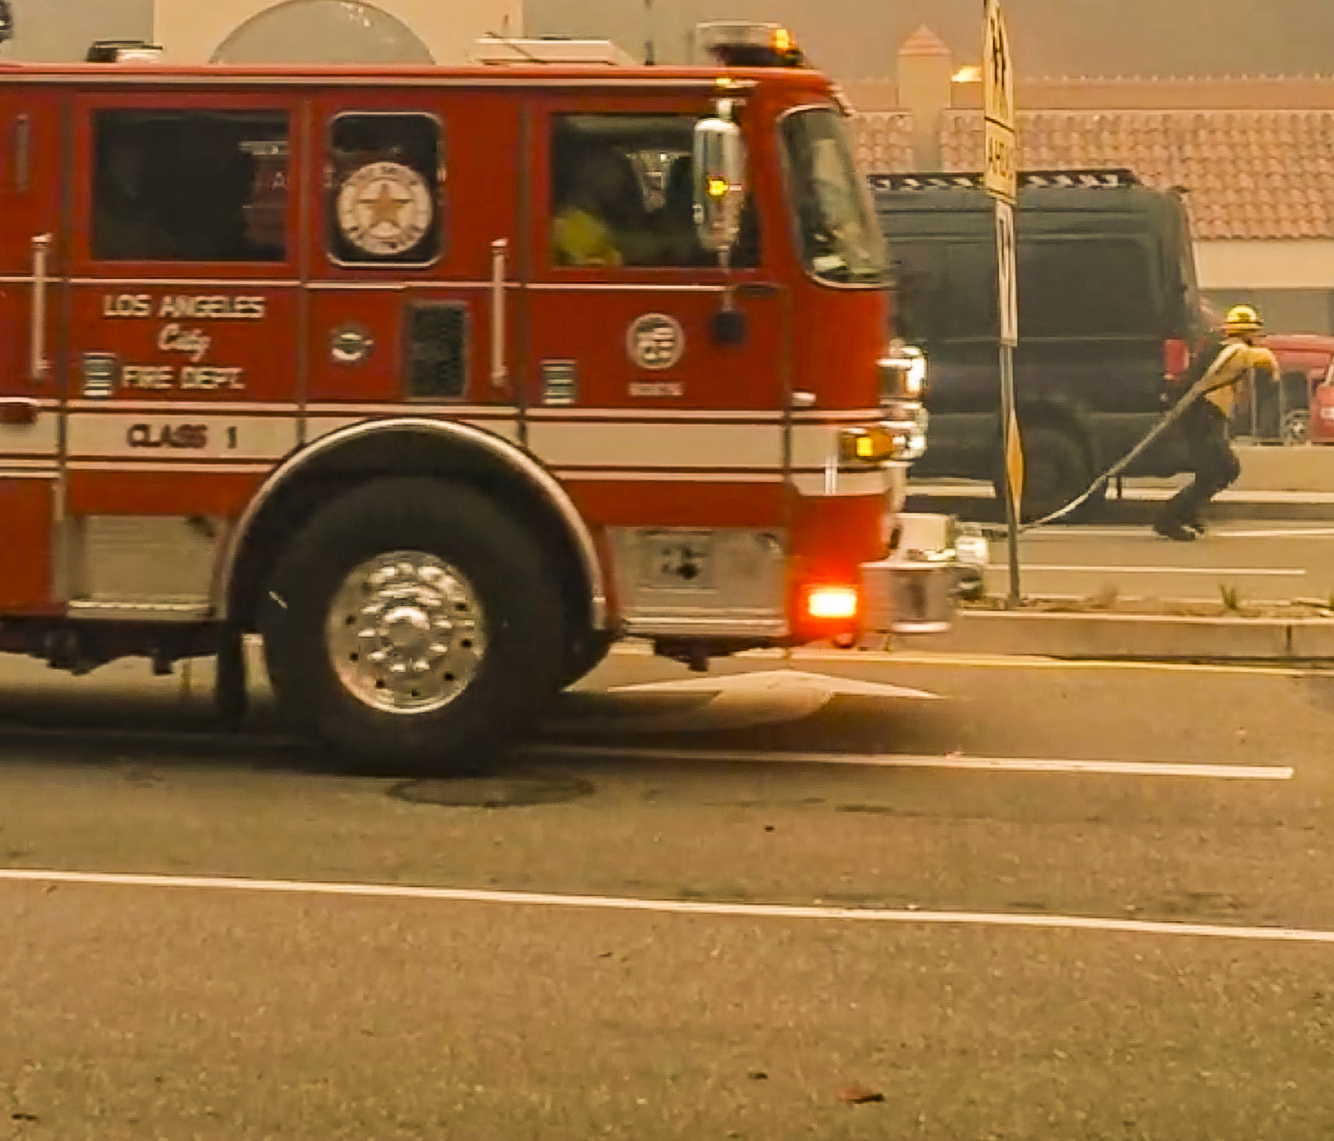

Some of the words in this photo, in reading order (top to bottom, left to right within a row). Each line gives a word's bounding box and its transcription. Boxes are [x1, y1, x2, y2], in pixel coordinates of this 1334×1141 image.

[103, 294, 152, 316] LOS
[157, 295, 266, 319] ANGELES
[157, 323, 212, 363] City
[122, 365, 174, 389] FIRE
[127, 423, 208, 449] CLASS
[226, 425, 238, 449] 1
